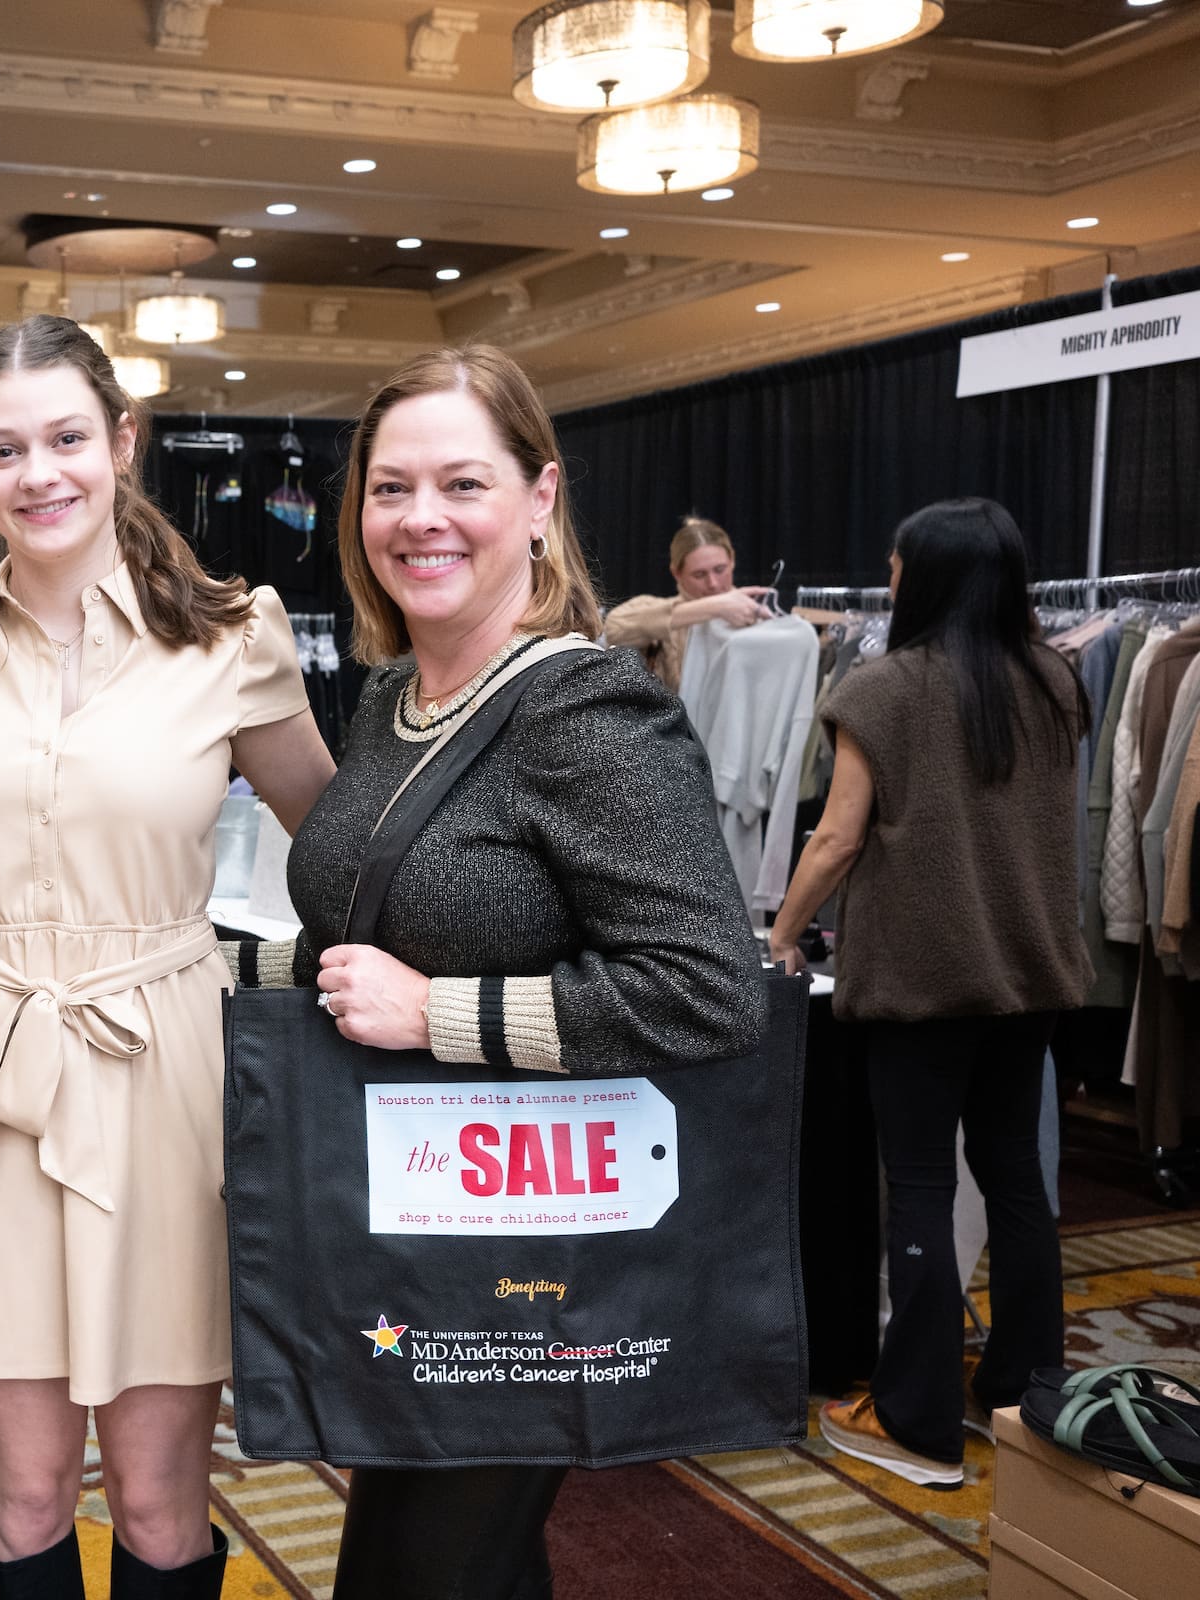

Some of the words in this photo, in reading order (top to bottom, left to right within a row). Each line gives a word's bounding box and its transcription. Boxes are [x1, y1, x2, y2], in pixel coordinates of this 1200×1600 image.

[1061, 330, 1107, 356] MIGHTY
[1110, 316, 1181, 347] APHRODITY
[378, 1096, 434, 1106] houston
[441, 1094, 464, 1105] tri
[471, 1094, 510, 1105] delta
[517, 1093, 577, 1104] alumnae
[583, 1090, 637, 1105] present
[406, 1141, 450, 1173] the
[459, 1121, 619, 1197] SALE
[398, 1212, 431, 1225] shop
[438, 1213, 452, 1224] to
[460, 1214, 494, 1224] cure
[500, 1211, 577, 1224] childhood
[584, 1210, 629, 1222] cancer
[496, 1278, 567, 1302] Benefiting
[410, 1330, 430, 1340] THE
[433, 1330, 492, 1340] UNIVERSITY
[495, 1332, 508, 1340] OF
[512, 1332, 544, 1340] TEXAS
[411, 1342, 449, 1361] MD
[450, 1341, 545, 1361] Anderson
[548, 1342, 614, 1360] Cancer
[616, 1337, 672, 1357] Center
[413, 1364, 506, 1384] Children's
[510, 1364, 578, 1382] Cancer
